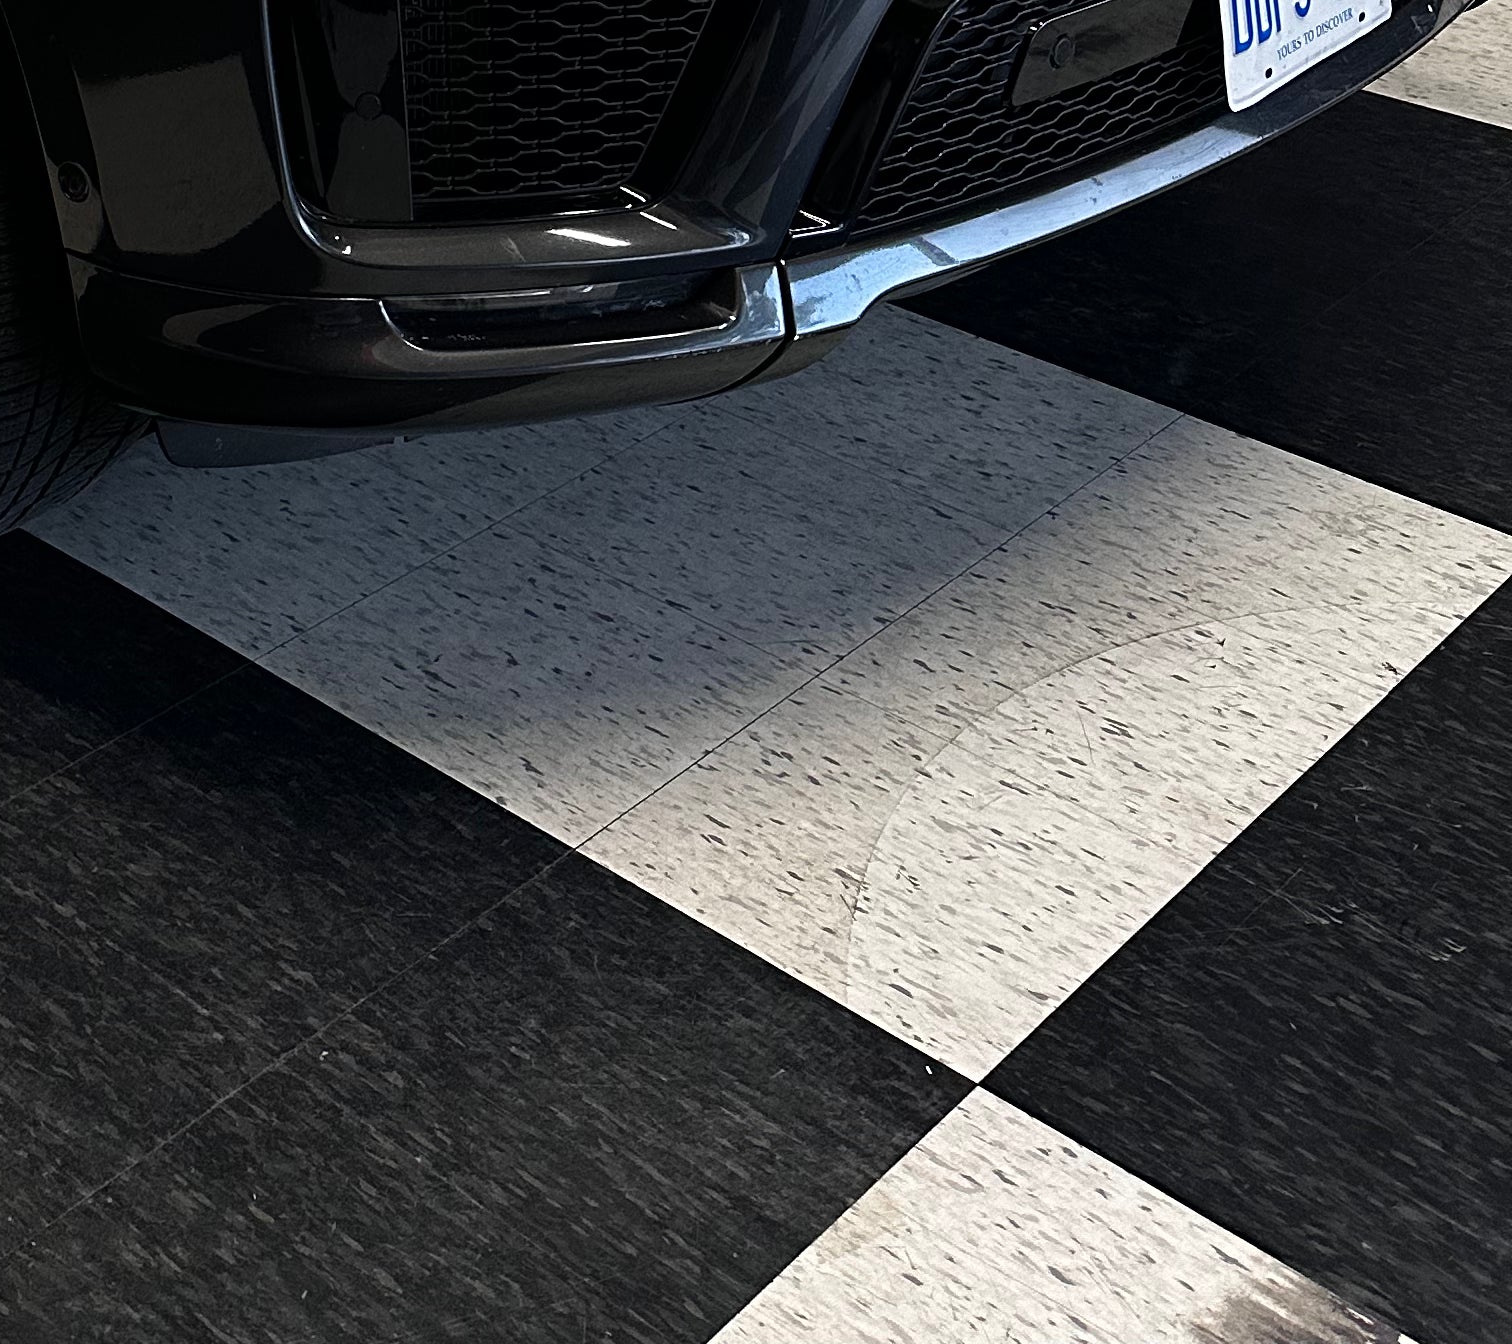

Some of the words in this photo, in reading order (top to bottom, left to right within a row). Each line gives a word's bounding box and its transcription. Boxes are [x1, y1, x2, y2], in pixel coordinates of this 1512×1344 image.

[1276, 38, 1302, 60] YOURS
[1303, 29, 1315, 44] TO
[1315, 7, 1353, 38] DISCOVER
